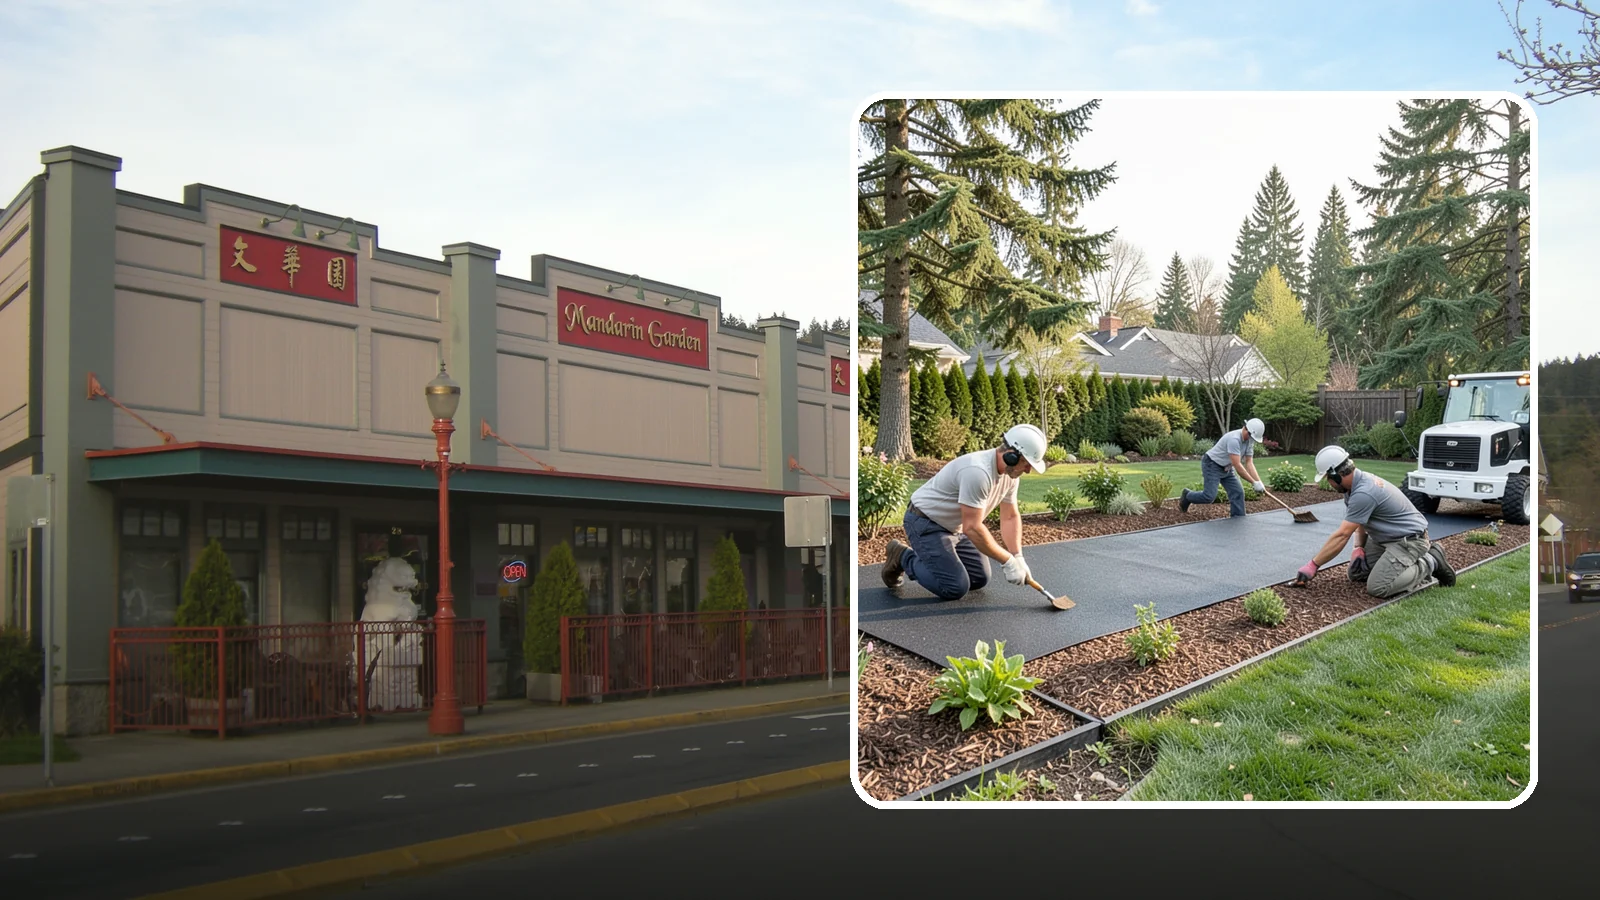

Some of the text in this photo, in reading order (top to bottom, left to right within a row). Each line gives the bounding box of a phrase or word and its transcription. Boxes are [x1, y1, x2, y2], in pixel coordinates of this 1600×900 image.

[230, 235, 347, 291] 文華園
[564, 302, 702, 352] Mandarin Garden
[503, 565, 527, 578] OPEN
